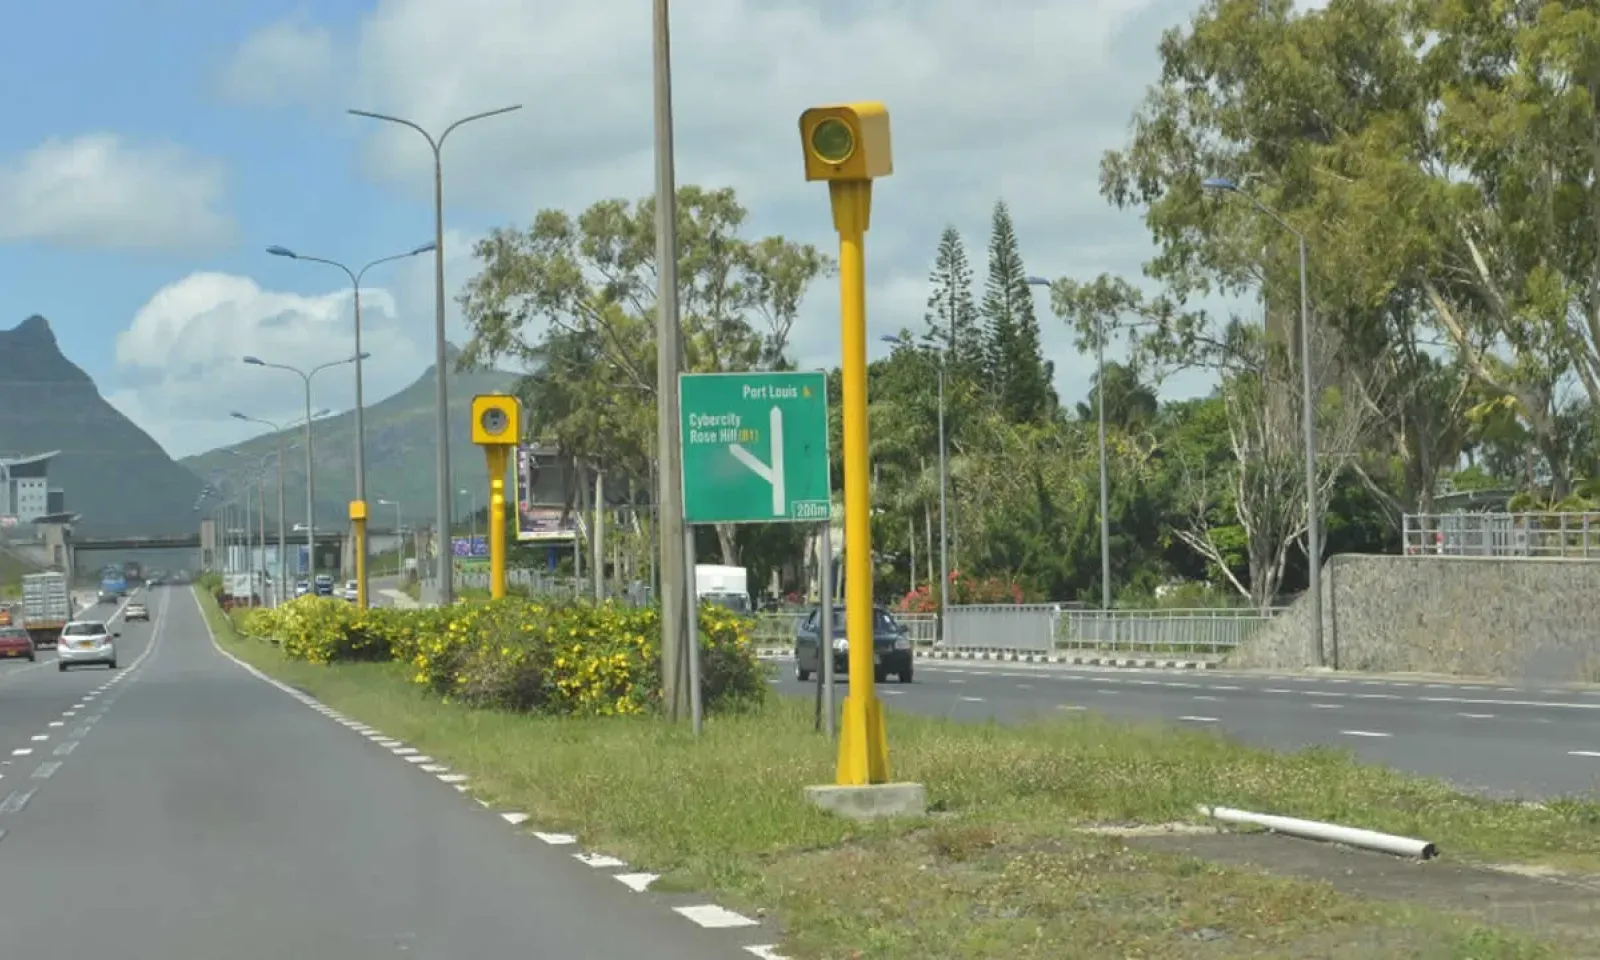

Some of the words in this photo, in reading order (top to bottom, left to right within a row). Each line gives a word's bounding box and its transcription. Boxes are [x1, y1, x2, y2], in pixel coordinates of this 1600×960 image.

[743, 384, 766, 398] Port
[769, 384, 798, 398] Louis
[690, 413, 741, 428] Cybercity
[690, 428, 717, 443] Rose
[720, 428, 737, 443] Hill
[796, 503, 828, 517] 200m
